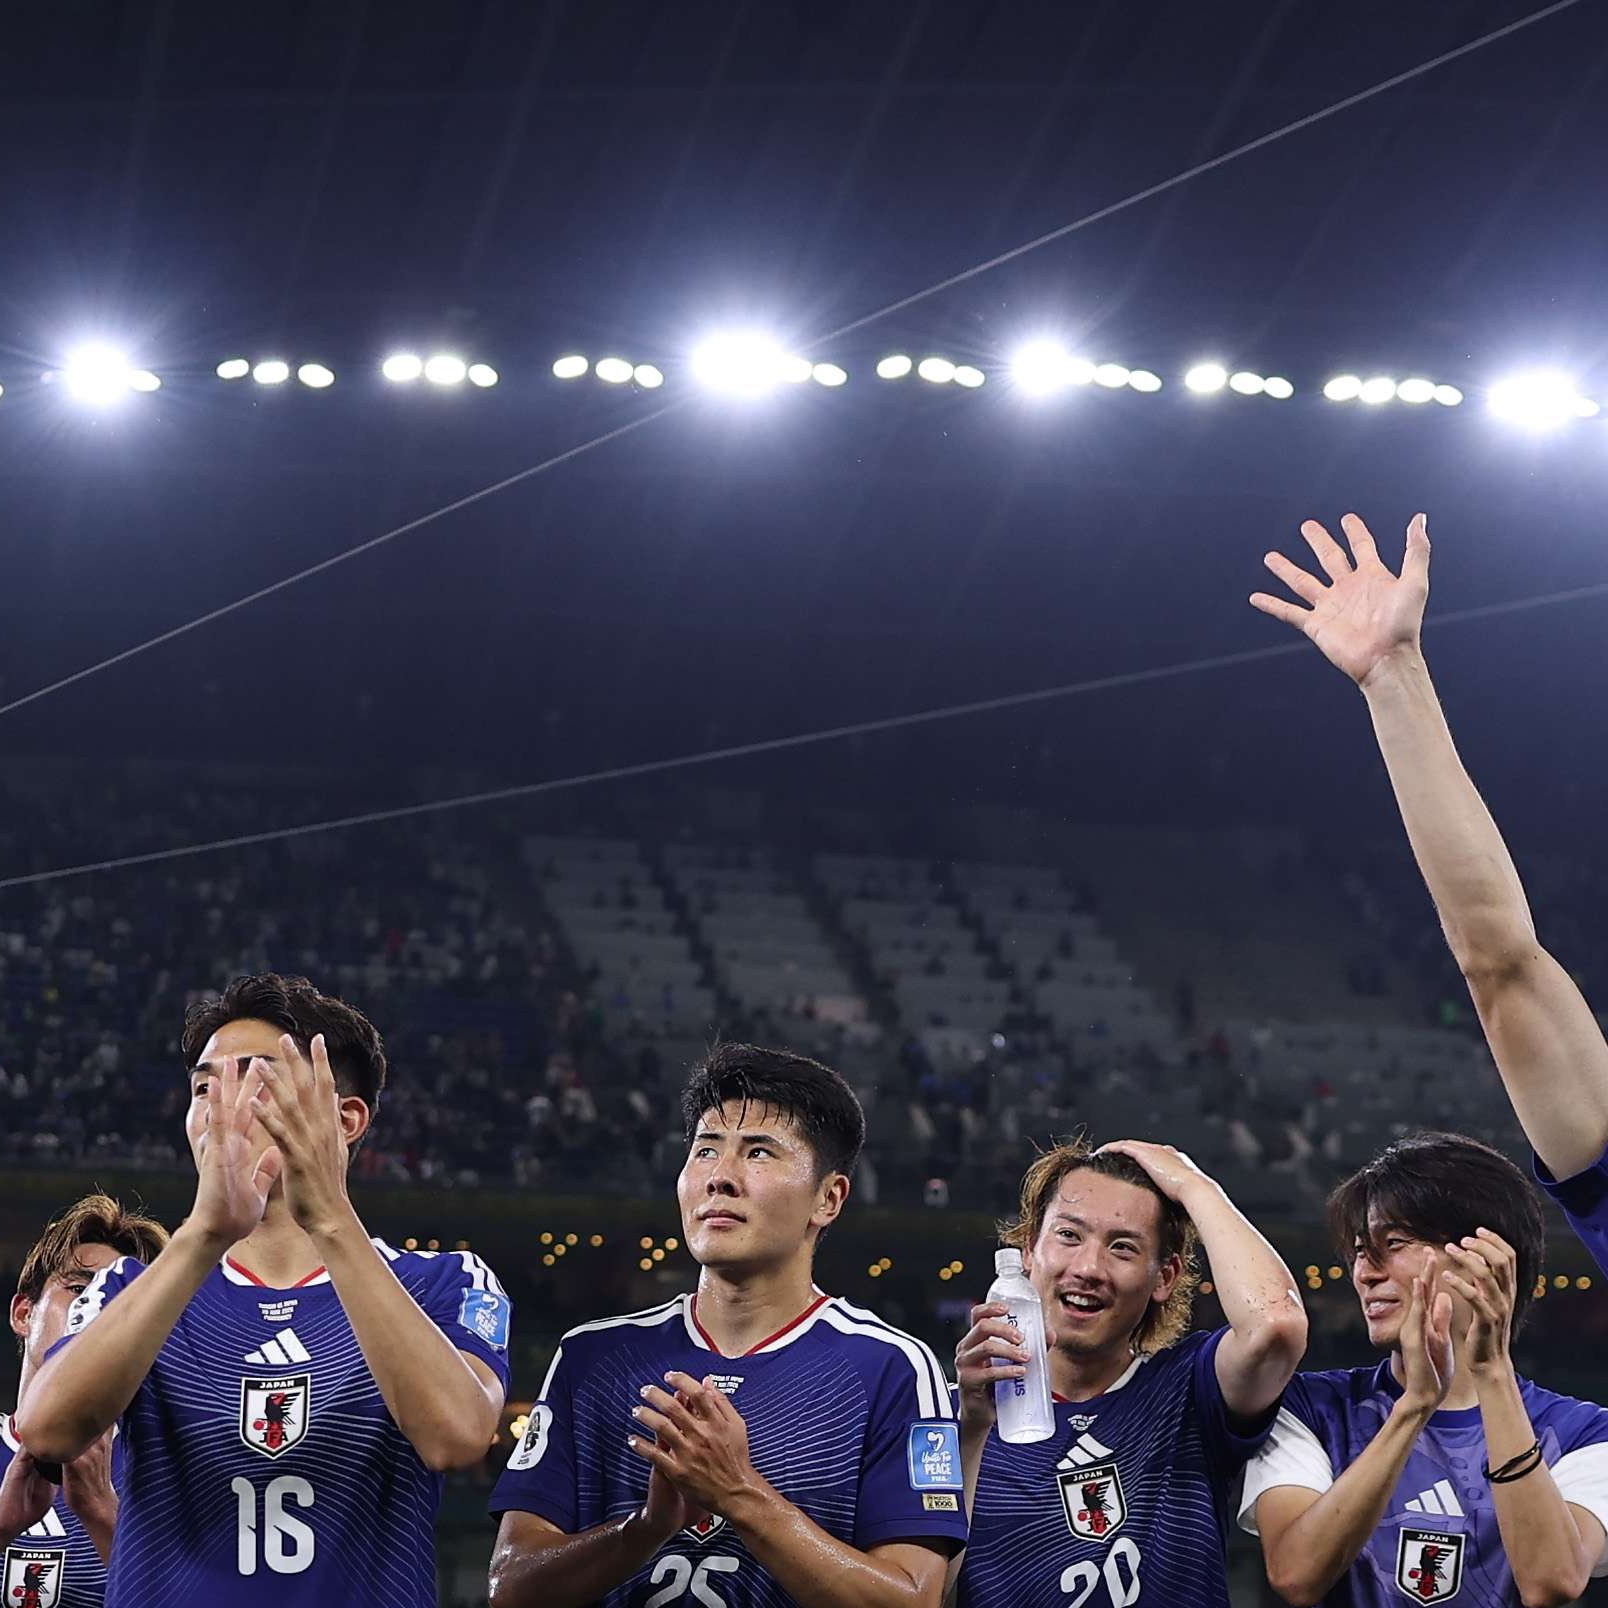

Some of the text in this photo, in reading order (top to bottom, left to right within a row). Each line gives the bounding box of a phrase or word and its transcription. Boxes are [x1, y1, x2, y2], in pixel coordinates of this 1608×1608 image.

[259, 1379, 295, 1389] JAPAN
[924, 1462, 953, 1475] PEACE
[1073, 1469, 1104, 1482] JAPAN
[231, 1475, 316, 1576] 16
[1417, 1533, 1449, 1543] JAPAN
[20, 1552, 52, 1560] JAPAN
